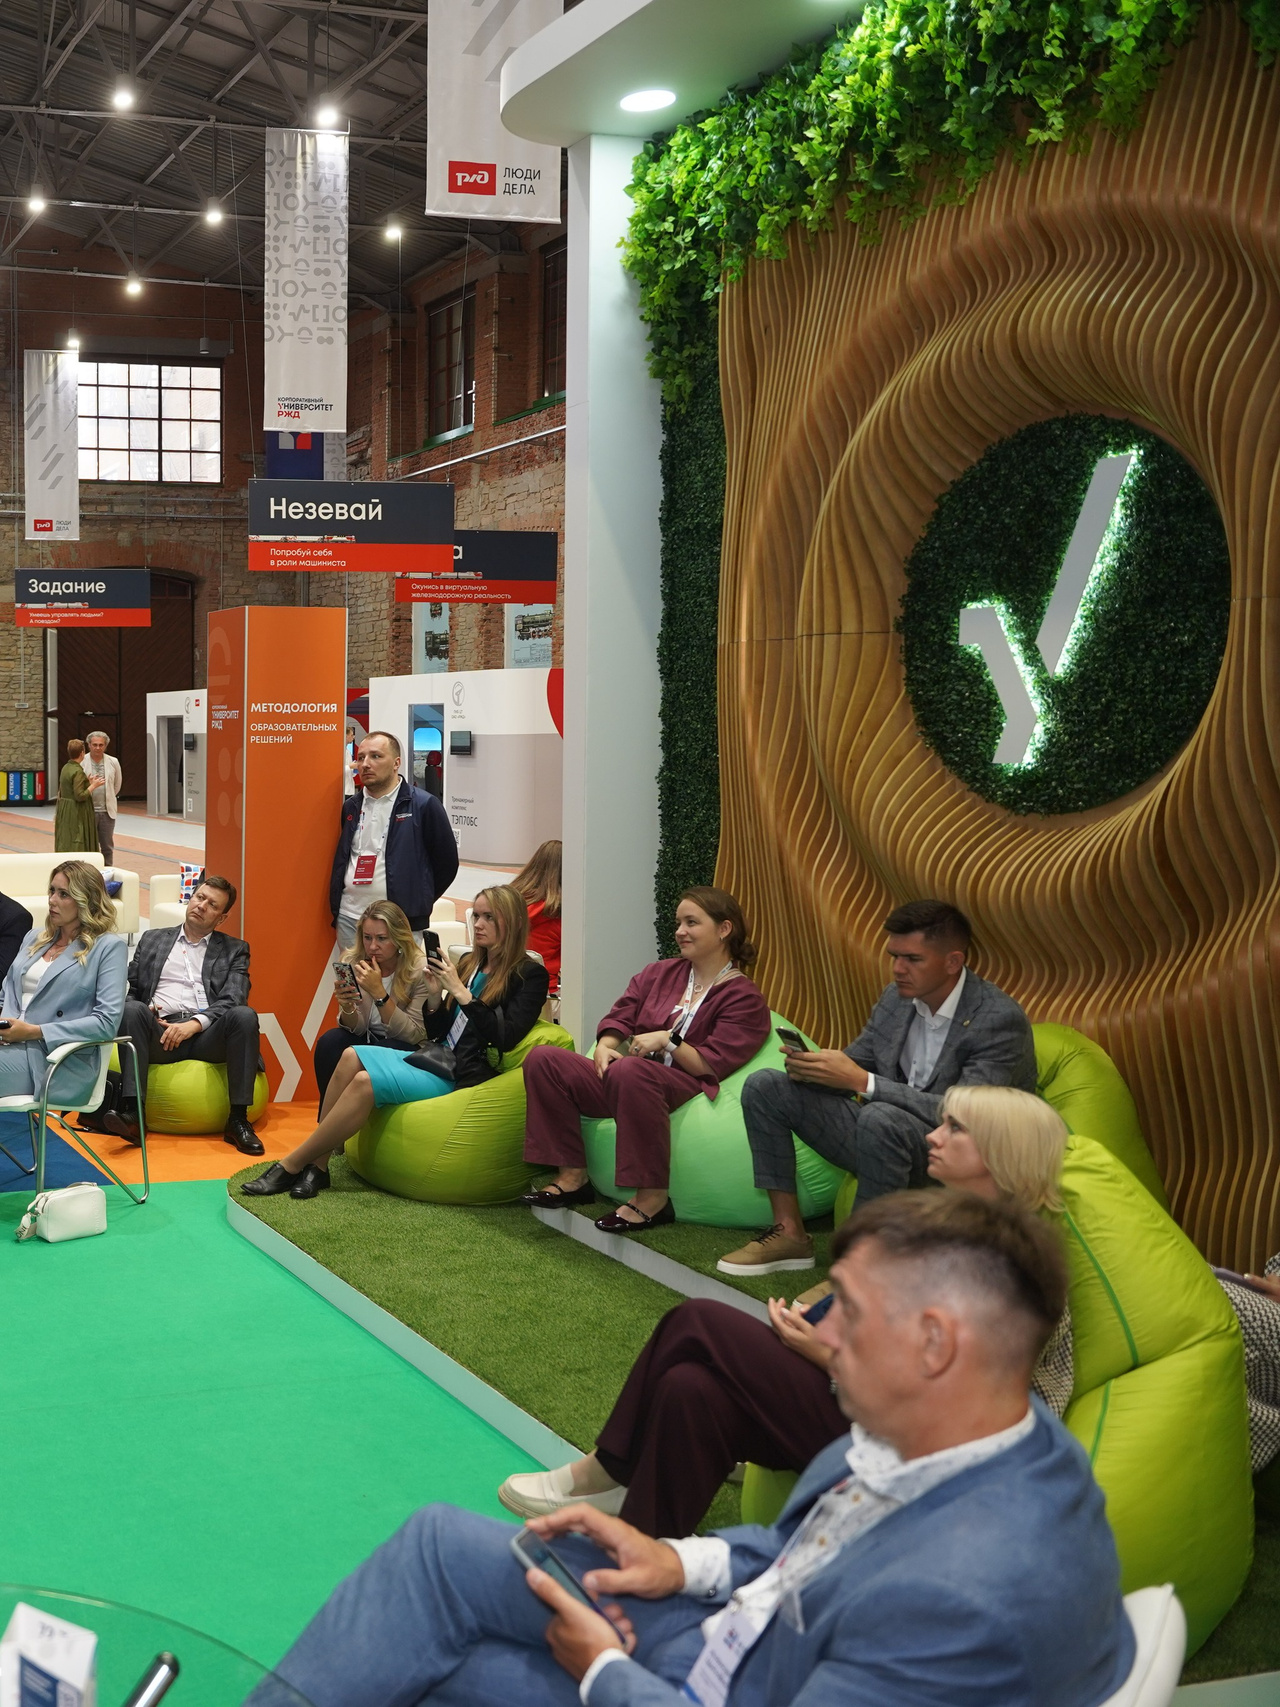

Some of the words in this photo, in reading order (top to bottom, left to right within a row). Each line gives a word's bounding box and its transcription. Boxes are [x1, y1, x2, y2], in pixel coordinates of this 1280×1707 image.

[503, 167, 541, 181] ЛЮДИ
[503, 183, 536, 195] ДЕЛА
[277, 403, 333, 411] УНИВЕРСИТЕТ
[277, 410, 300, 419] РЖД
[269, 497, 383, 521] Незевай
[270, 548, 311, 557] Попробуй
[312, 548, 333, 556] себя
[28, 578, 107, 596] Задание
[444, 583, 488, 591] виртуальную
[411, 592, 473, 600] железнодорожную
[250, 703, 338, 714] МЕТОДОЛОГИЯ
[212, 710, 239, 719] УНИВЕРСИТЕТ
[250, 723, 338, 731] ОБРАЗОВАТЕЛЬНЫХ
[250, 733, 293, 743] РЕШЕНИЙ
